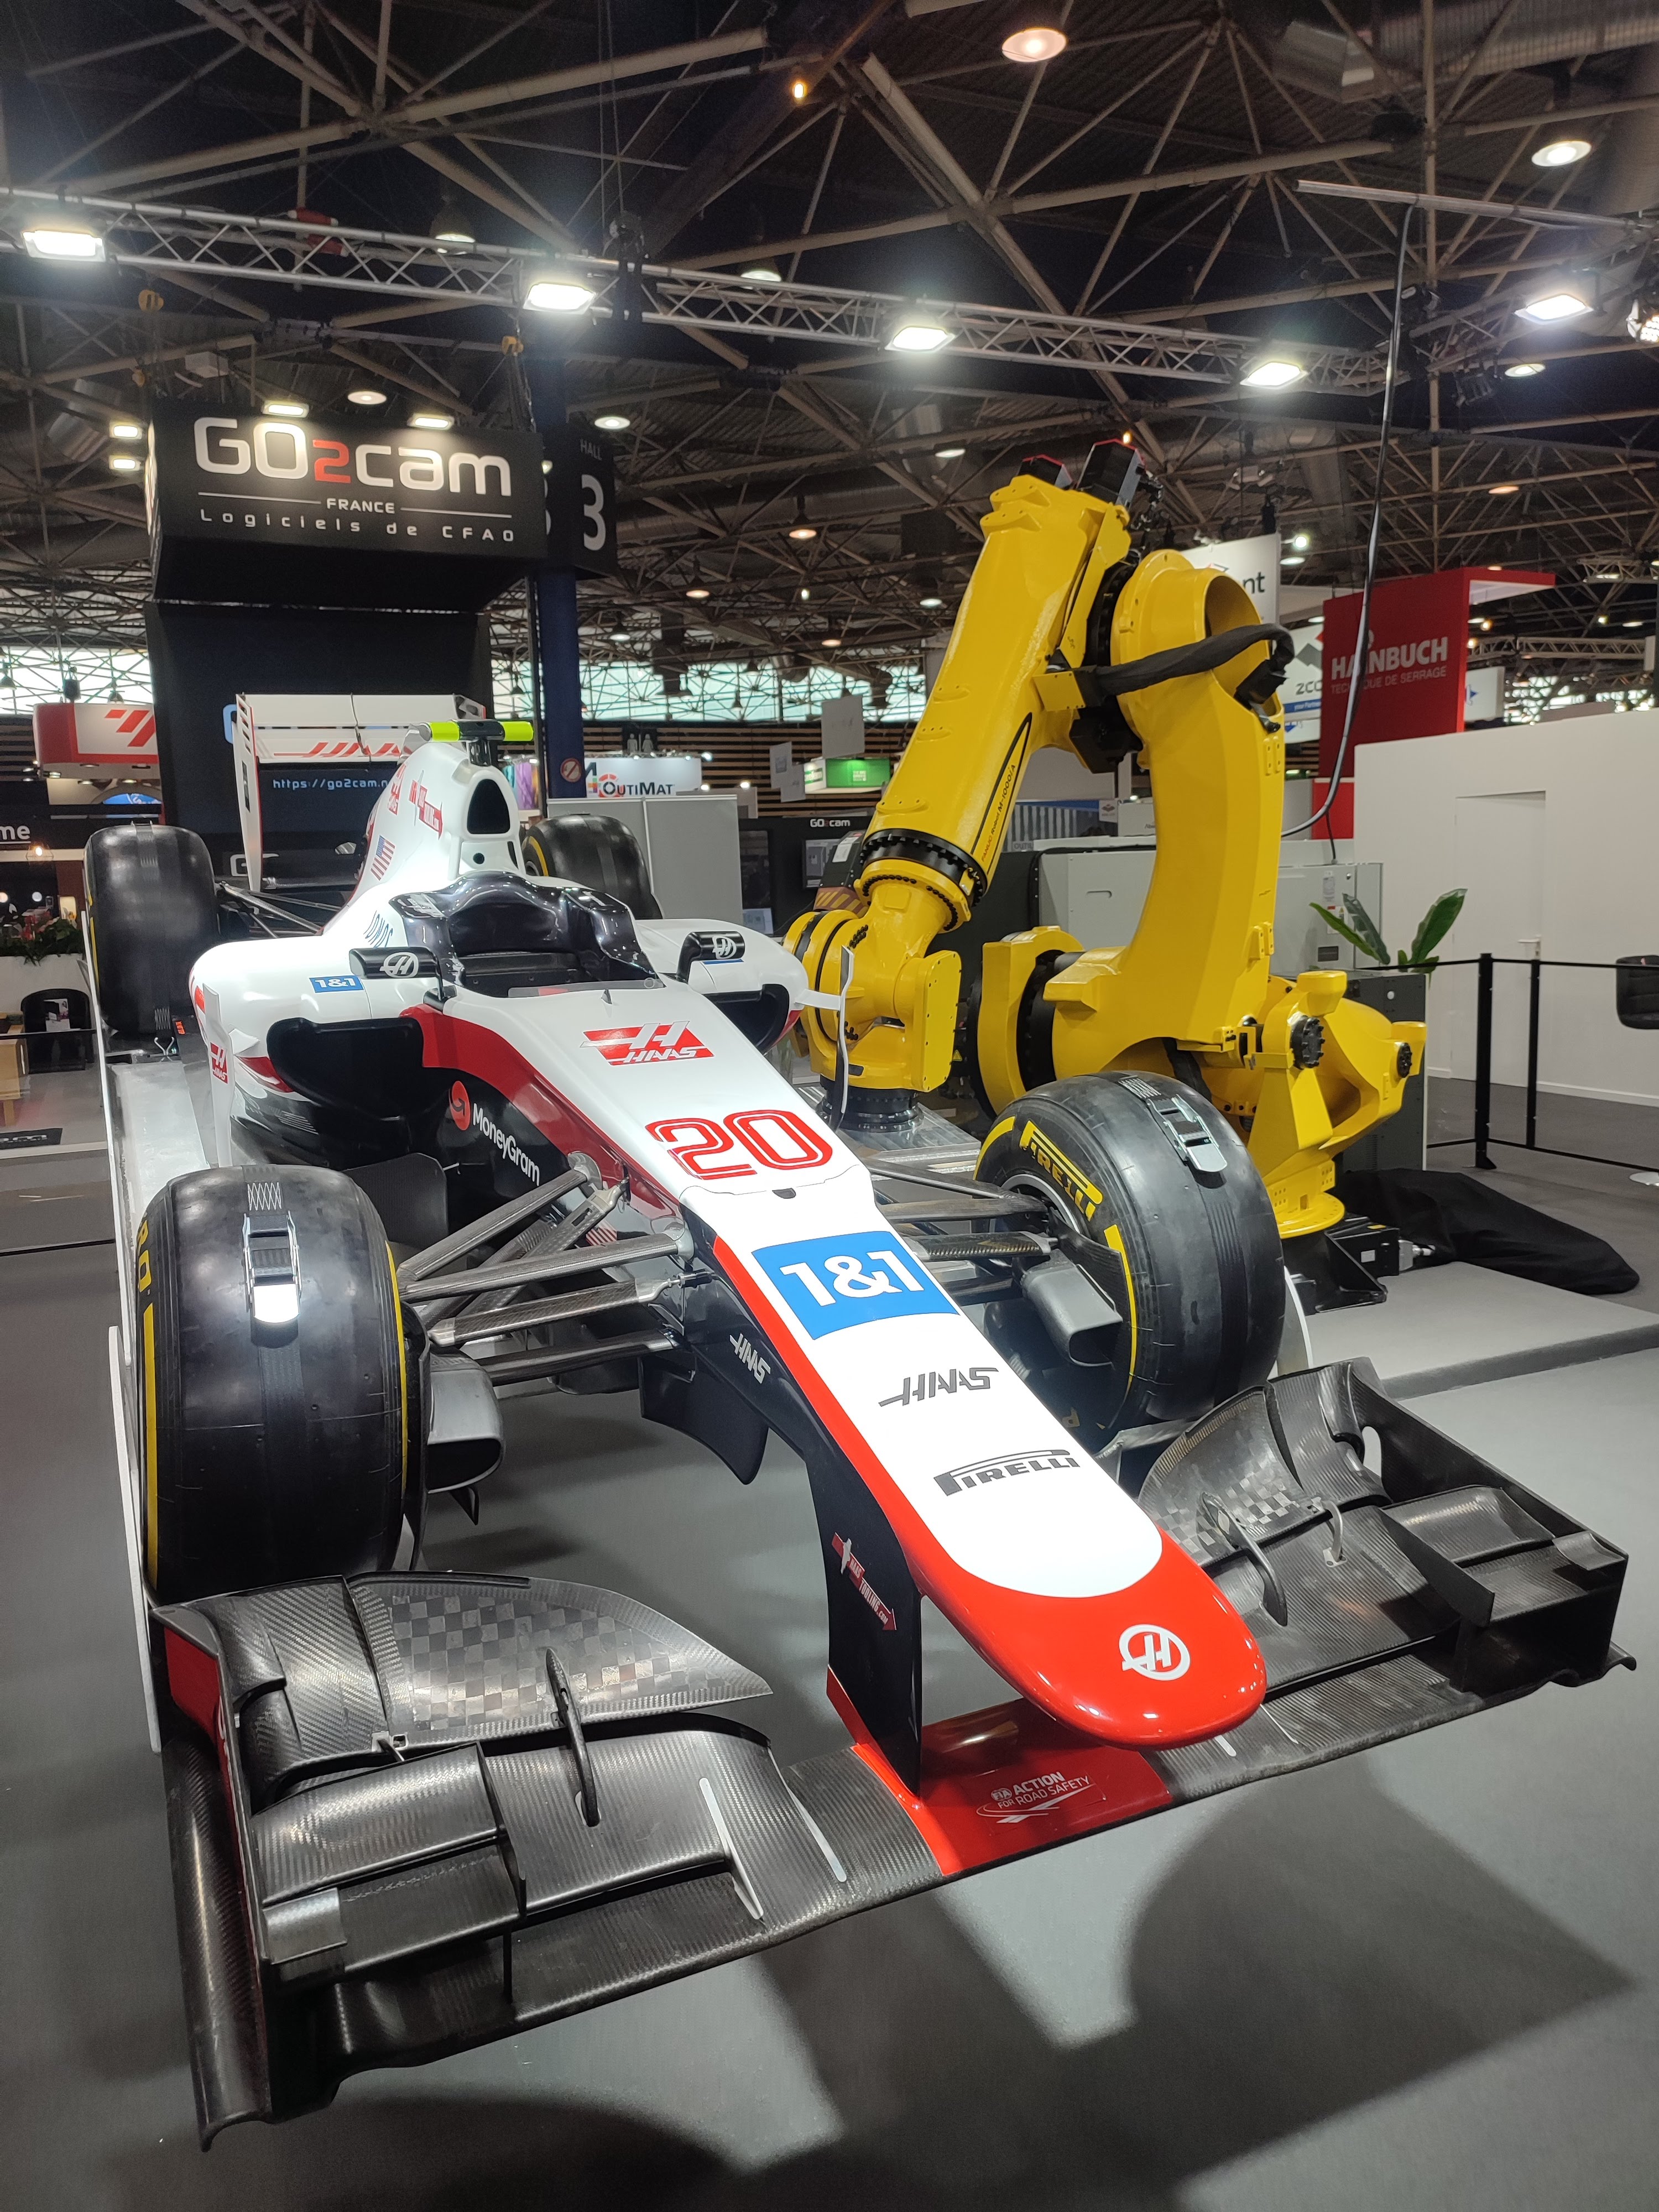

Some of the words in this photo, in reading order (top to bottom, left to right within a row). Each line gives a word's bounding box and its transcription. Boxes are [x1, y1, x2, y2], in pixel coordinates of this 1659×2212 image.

[194, 417, 512, 497] GO2cam
[580, 439, 602, 460] HALL
[200, 509, 361, 532] Logiciels
[387, 522, 417, 536] de
[442, 525, 514, 542] CFAO
[327, 498, 395, 514] FRANCE
[582, 474, 606, 551] 3
[1331, 636, 1448, 680] HANBUCH
[1384, 674, 1398, 686] DE
[1400, 665, 1447, 684] SERRAGE
[982, 836, 993, 862] FANUC
[991, 811, 1000, 836] Robot
[315, 978, 356, 988] 1&1
[212, 1067, 227, 1081] HAAS
[608, 1046, 706, 1063] HAAS
[473, 1103, 540, 1186] MoneyGram
[645, 1109, 833, 1180] 20
[1019, 1120, 1104, 1222] PIRELLI
[779, 1250, 925, 1307] 1&1
[729, 1333, 771, 1384] HAAS
[878, 1367, 999, 1407] HAAS
[933, 1449, 1081, 1496] PIRELLI
[849, 1558, 862, 1579] HAAS
[992, 1789, 1011, 1801] FIA
[1013, 1771, 1066, 1796] ACTION
[998, 1798, 1015, 1809] FOR
[1015, 1788, 1048, 1806] ROAD
[1050, 1775, 1091, 1796] SAFETY
